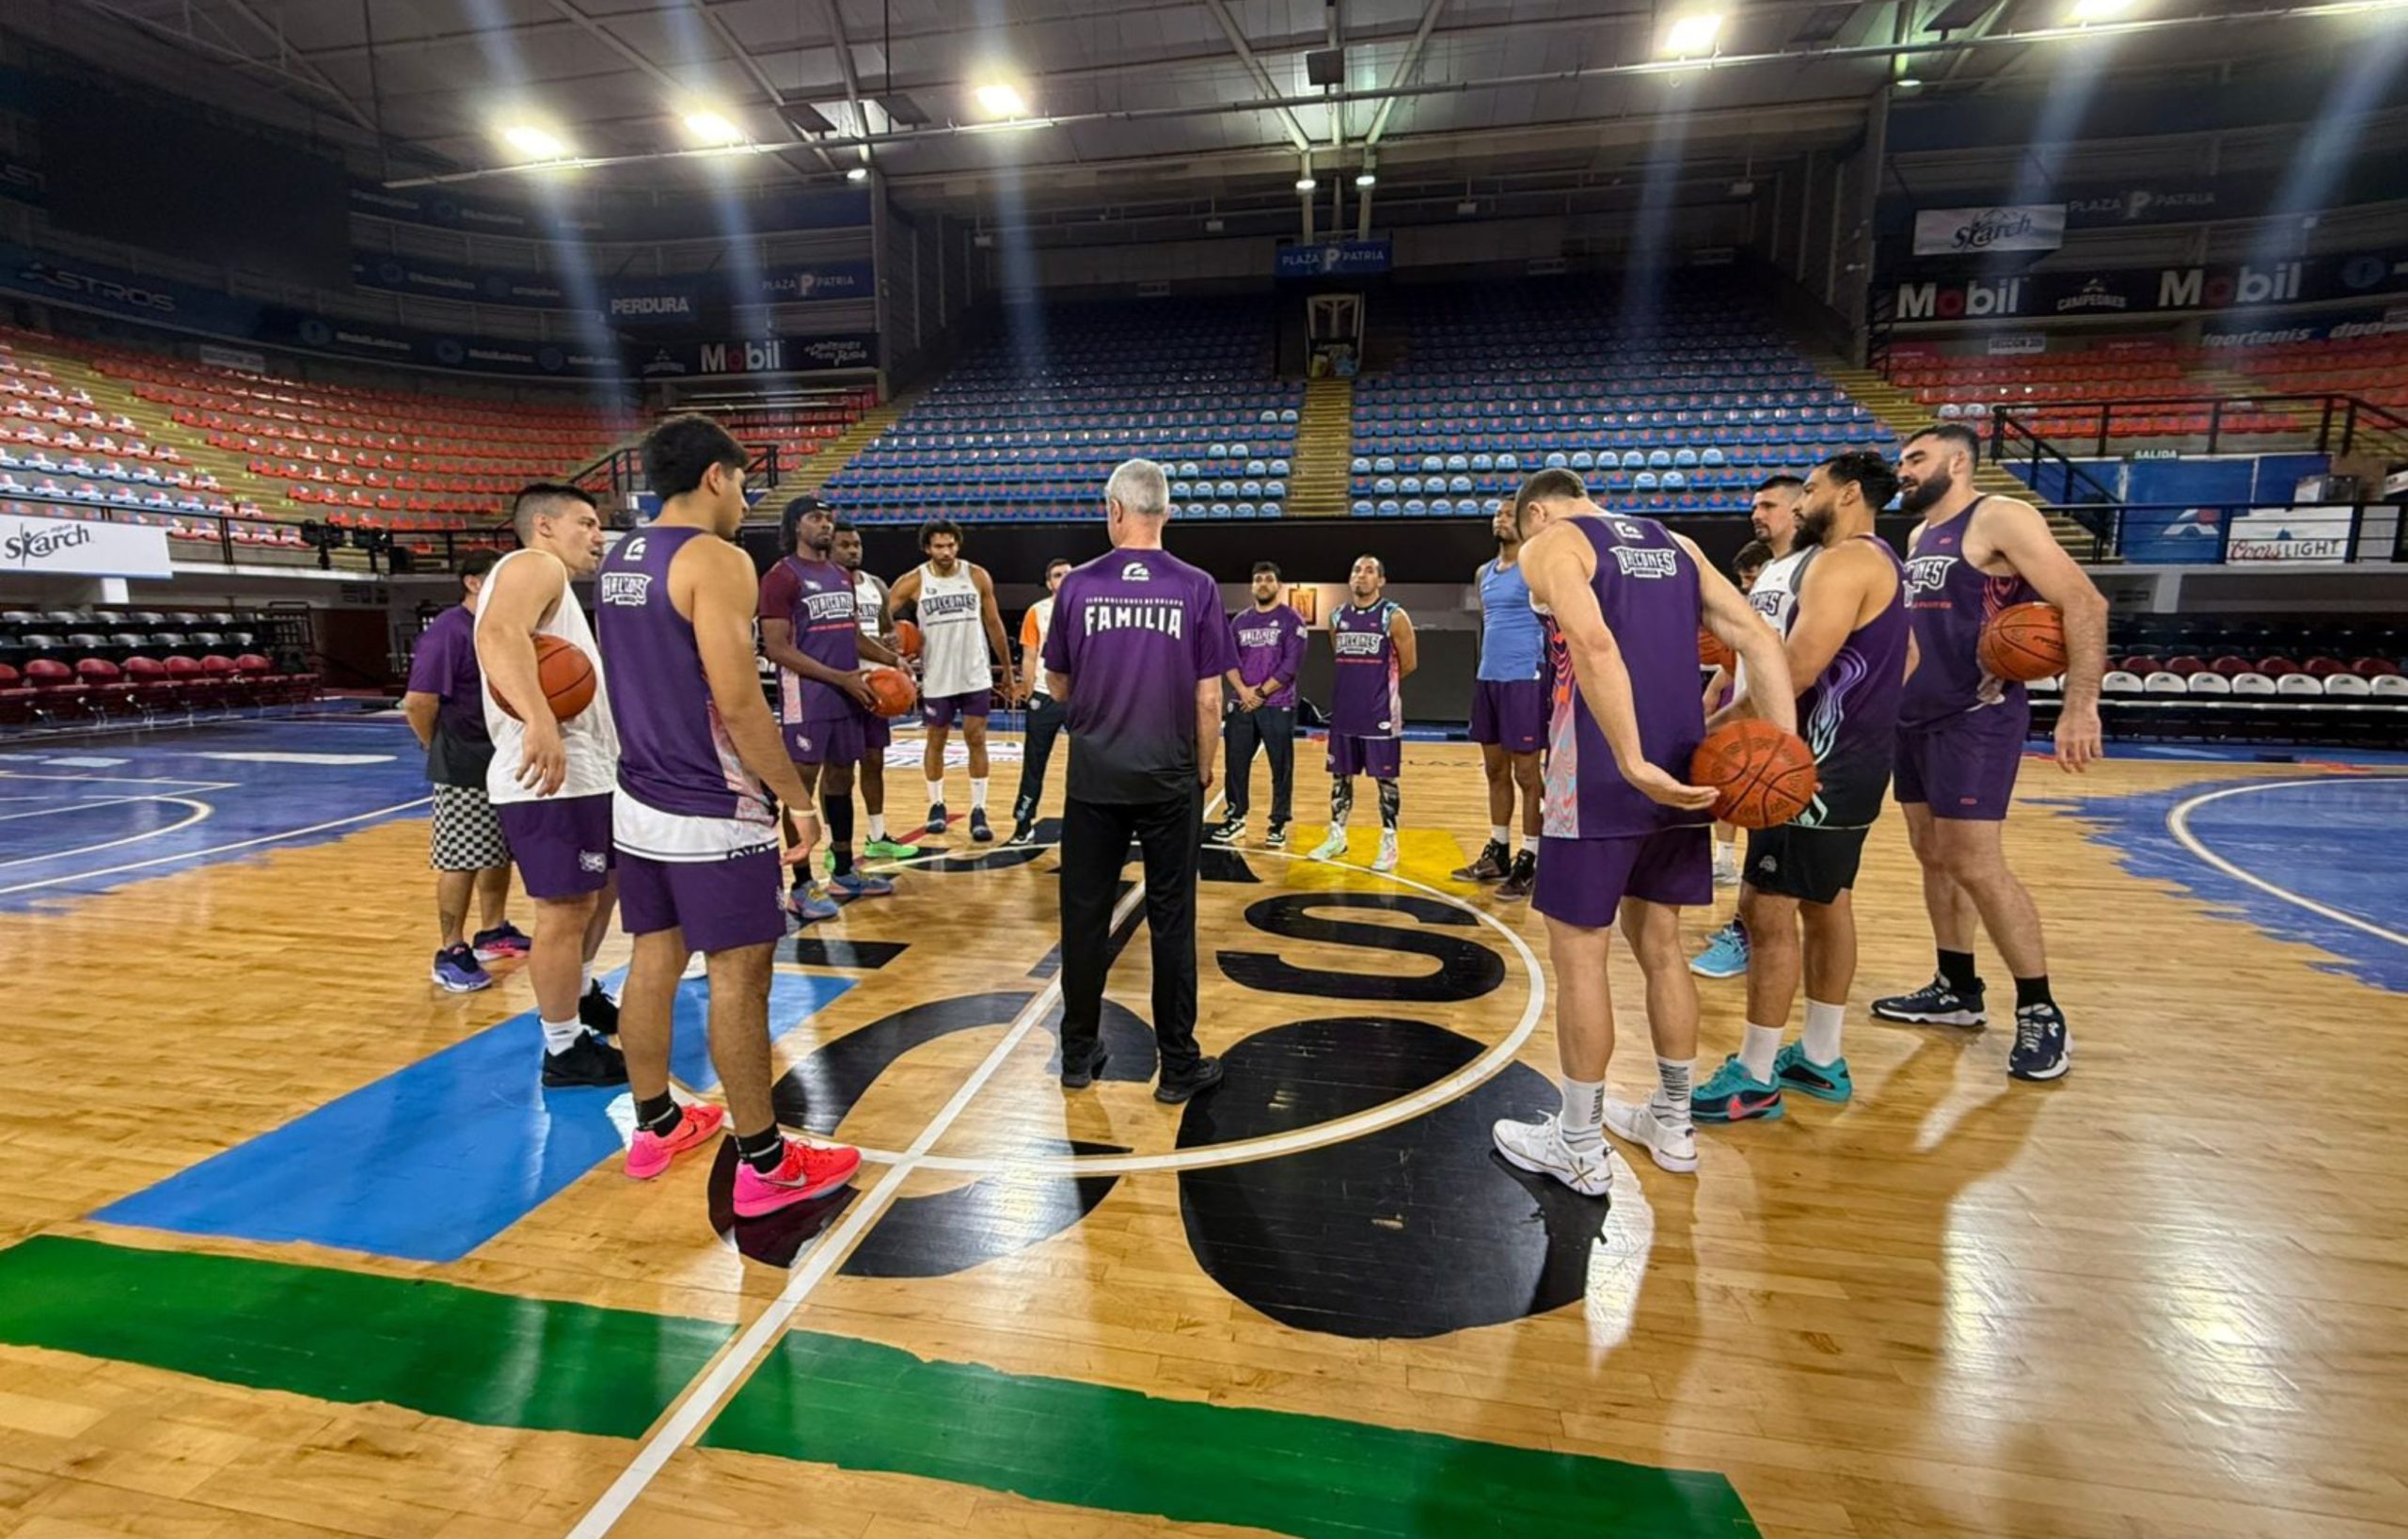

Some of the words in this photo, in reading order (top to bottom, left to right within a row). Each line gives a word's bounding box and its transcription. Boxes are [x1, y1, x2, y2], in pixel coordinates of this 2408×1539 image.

[2069, 198, 2121, 212] PLAZA
[2155, 192, 2216, 207] PATRIA
[1281, 254, 1320, 266] PLAZA
[1342, 250, 1385, 262] PATRIA
[816, 275, 855, 288] PATRIA
[2157, 263, 2303, 308] Mobil
[610, 296, 690, 315] PERDURA
[1896, 277, 2021, 319] Mobil
[700, 340, 782, 374] Mobil
[2133, 450, 2178, 460] SALIDA
[5, 523, 90, 567] Starch
[2283, 539, 2341, 558] LIGHT
[1085, 605, 1182, 641] FAMILIA
